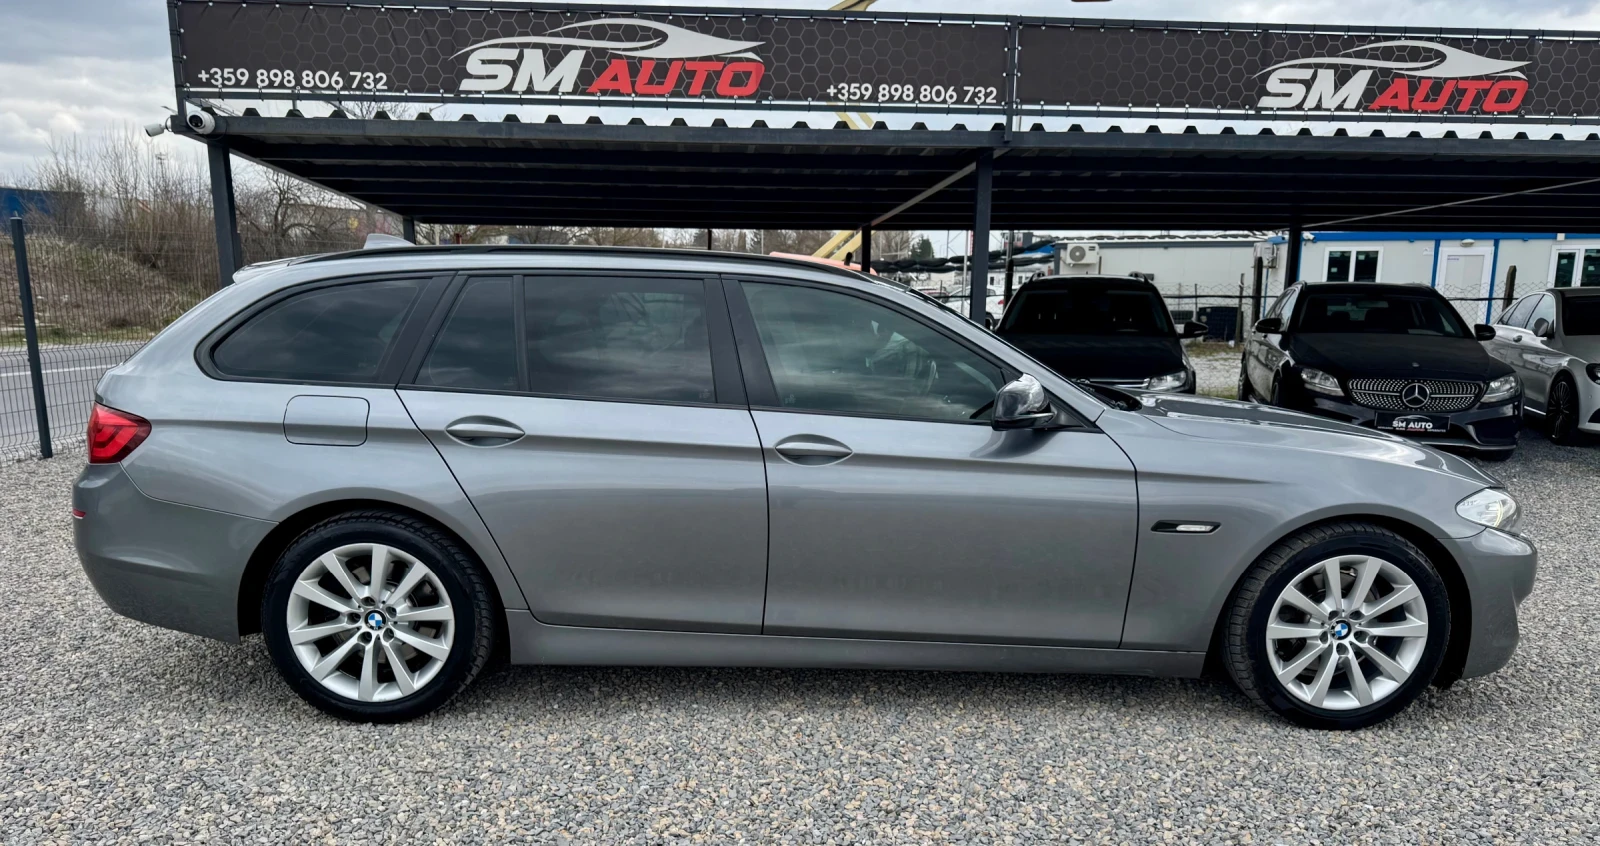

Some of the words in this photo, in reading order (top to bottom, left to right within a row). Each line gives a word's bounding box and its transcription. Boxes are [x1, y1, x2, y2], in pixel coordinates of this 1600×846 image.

[198, 67, 249, 86] +359
[256, 69, 296, 87] 898
[301, 70, 344, 89] 806
[350, 71, 388, 90] 732
[458, 48, 587, 93] SM
[586, 58, 765, 97] AUTO
[827, 83, 873, 100] +359
[878, 84, 914, 101] 898
[919, 85, 958, 103] 806
[963, 86, 997, 104] 732
[1257, 67, 1374, 109] SM
[1368, 78, 1529, 112] AUTO
[1392, 420, 1406, 428] SM
[1408, 421, 1433, 429] AUTO
